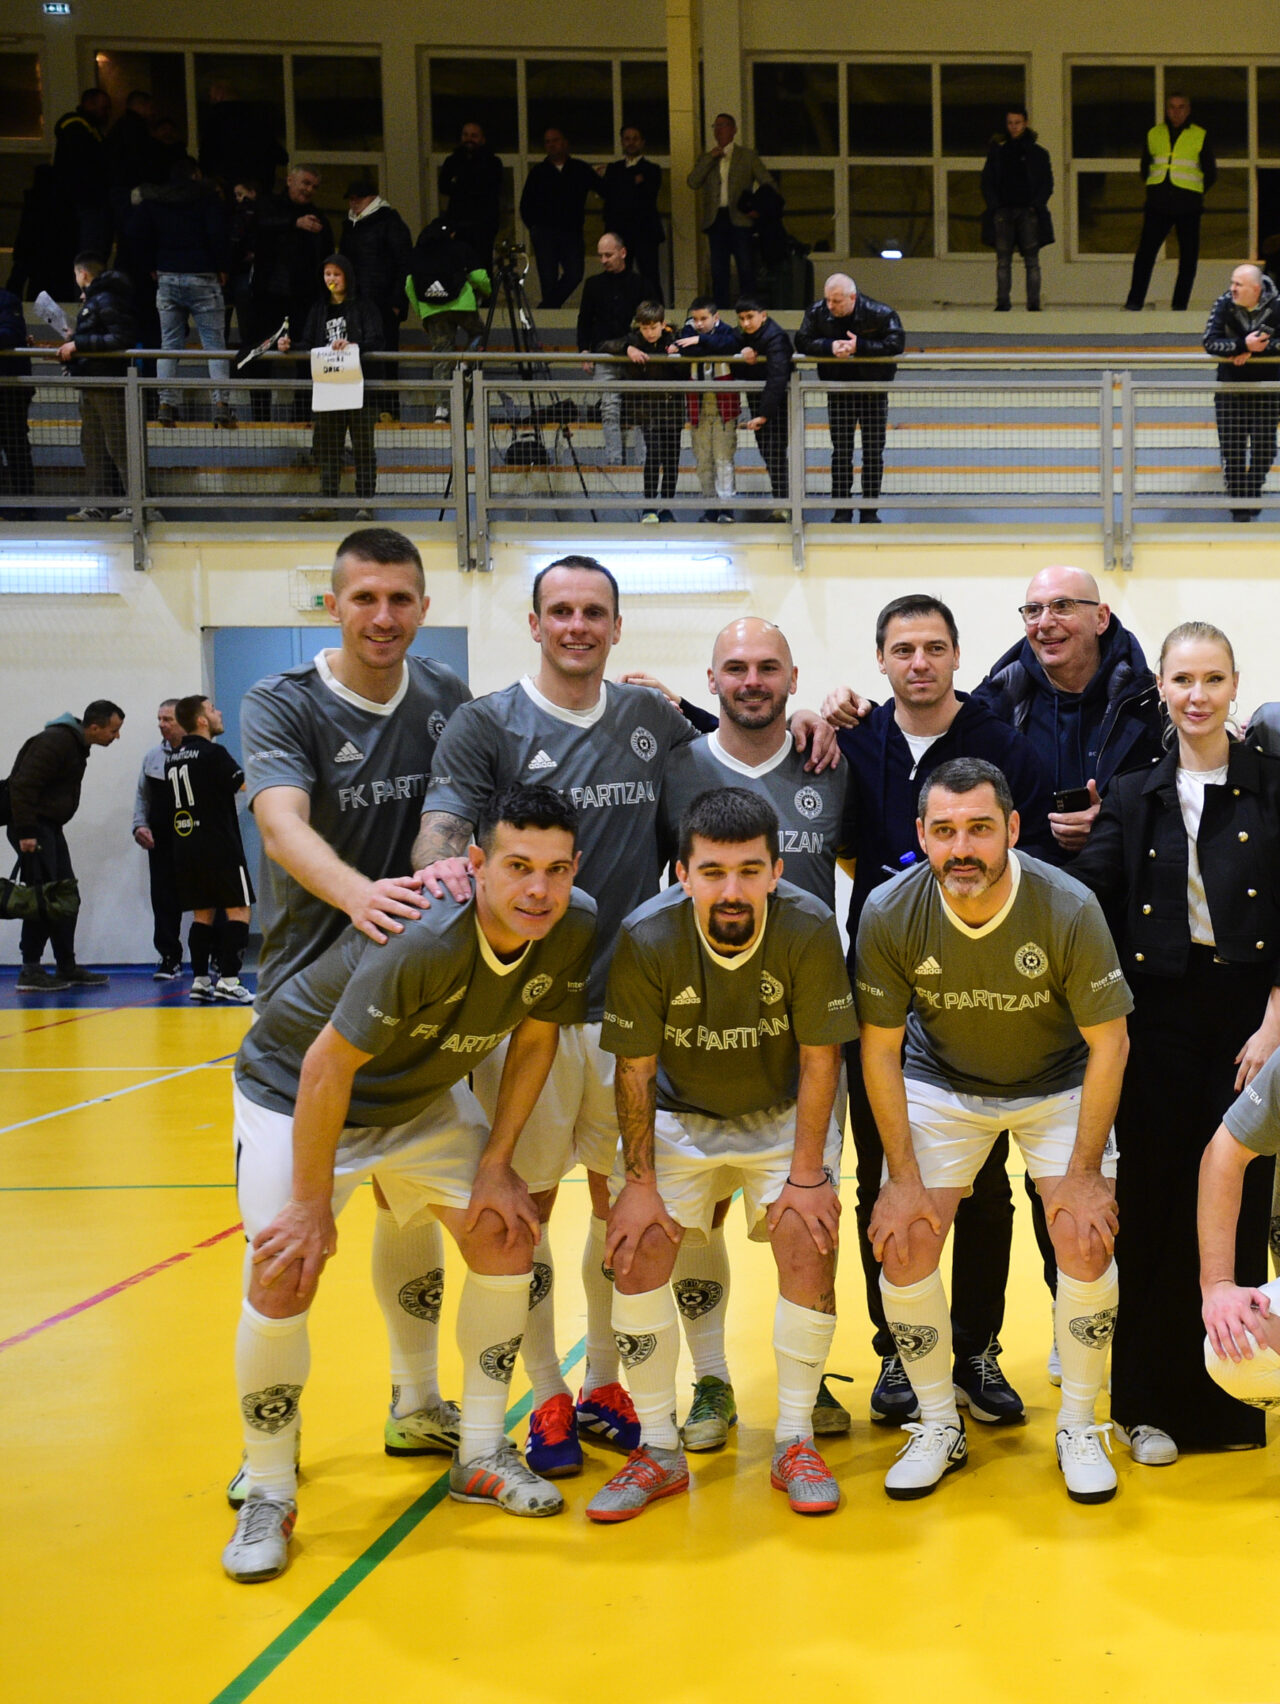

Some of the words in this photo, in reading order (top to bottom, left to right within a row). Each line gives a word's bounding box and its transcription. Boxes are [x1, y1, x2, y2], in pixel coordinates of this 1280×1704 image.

[528, 760, 558, 769] adidas
[168, 764, 195, 808] 11
[338, 784, 369, 812] FK
[371, 773, 431, 805] PARTI
[671, 997, 701, 1006] adidas
[943, 989, 1050, 1012] PARTIZAN
[664, 1024, 693, 1048] FK
[696, 1014, 790, 1051] PARTIAN
